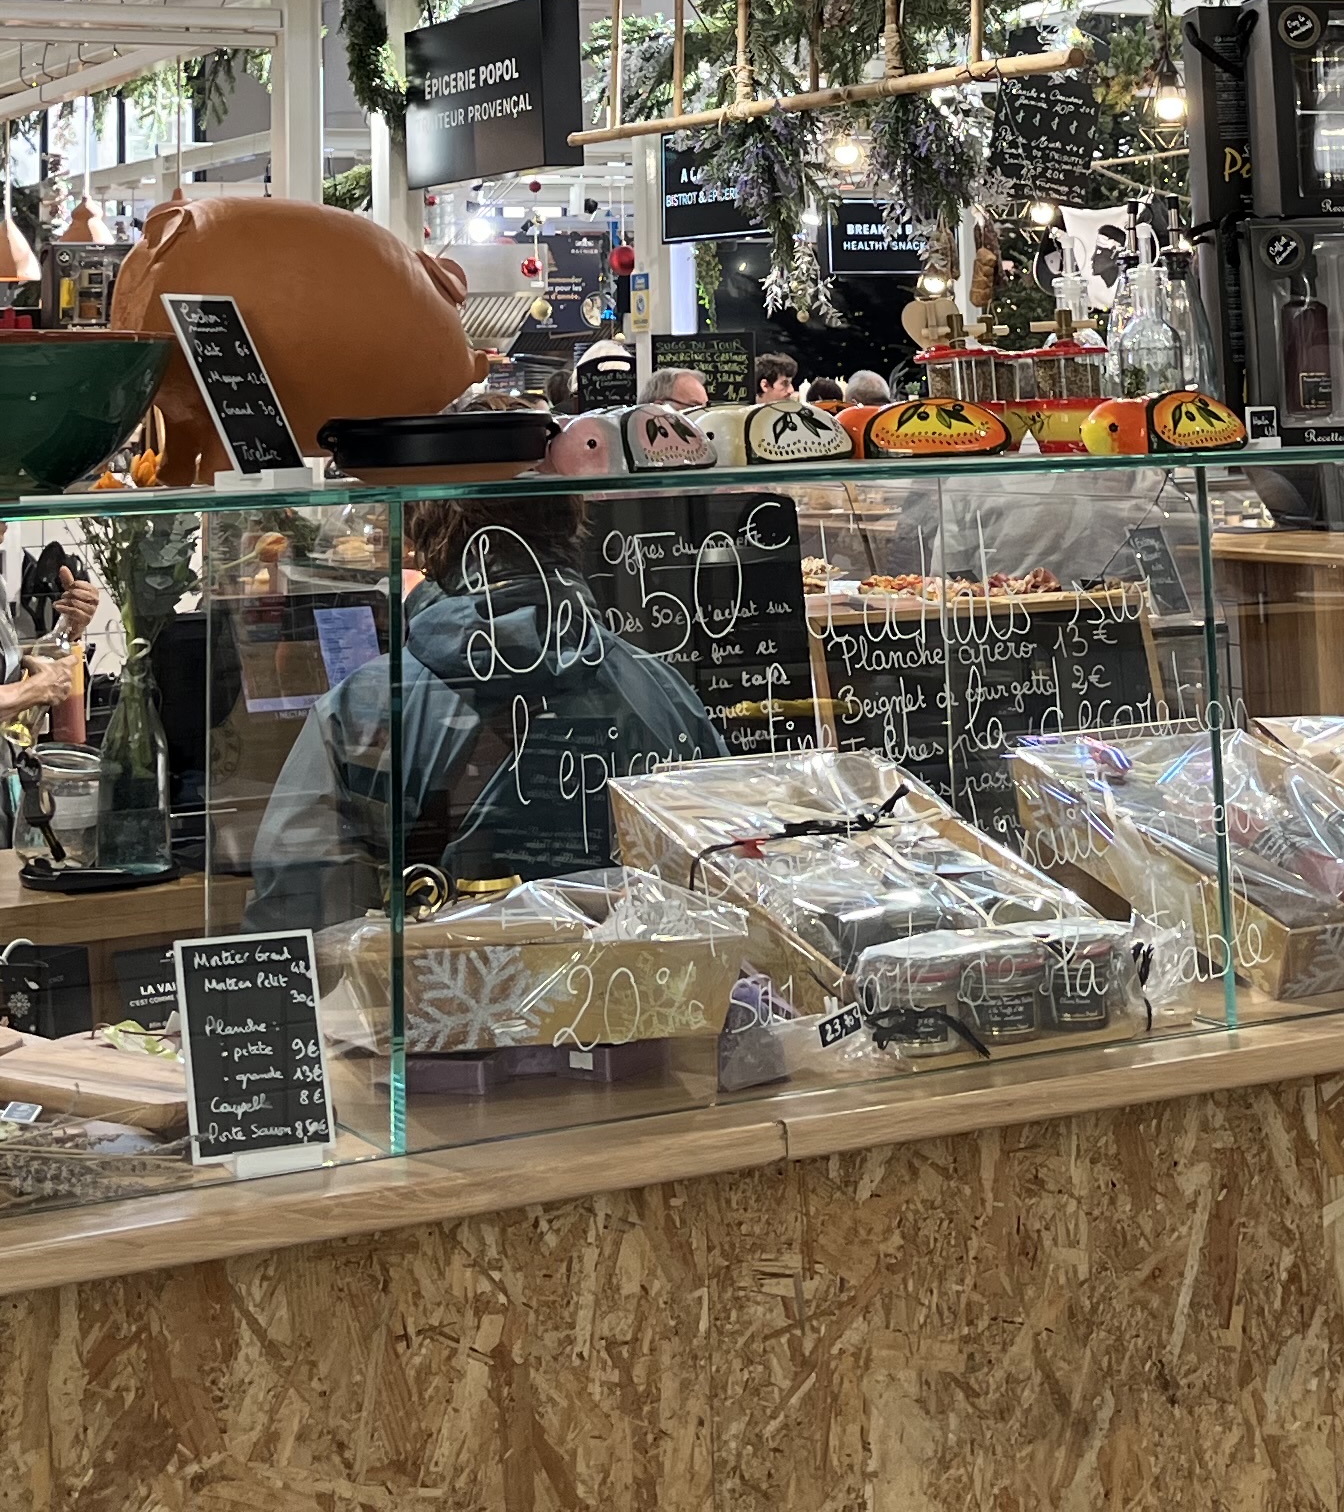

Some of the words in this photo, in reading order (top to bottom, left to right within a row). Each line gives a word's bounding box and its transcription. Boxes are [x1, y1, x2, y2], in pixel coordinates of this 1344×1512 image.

[424, 71, 476, 101] ÉPICERIE
[479, 57, 519, 87] POPOL
[467, 92, 533, 125] PROVENÇAL
[666, 191, 697, 208] BISTROT
[842, 240, 889, 251] HEALTHY
[603, 529, 665, 575] Offres
[672, 537, 698, 557] du
[461, 524, 605, 681] Dès
[631, 501, 791, 660] 50€
[606, 607, 644, 635] Dès
[767, 600, 794, 614] sur
[711, 639, 744, 665] fine
[756, 639, 778, 655] et
[828, 635, 949, 676] Planche
[1053, 619, 1119, 658] 13€
[838, 683, 926, 725] Beignet
[194, 949, 249, 969] Mortier
[140, 984, 156, 996] LA
[293, 1064, 324, 1082] 13€
